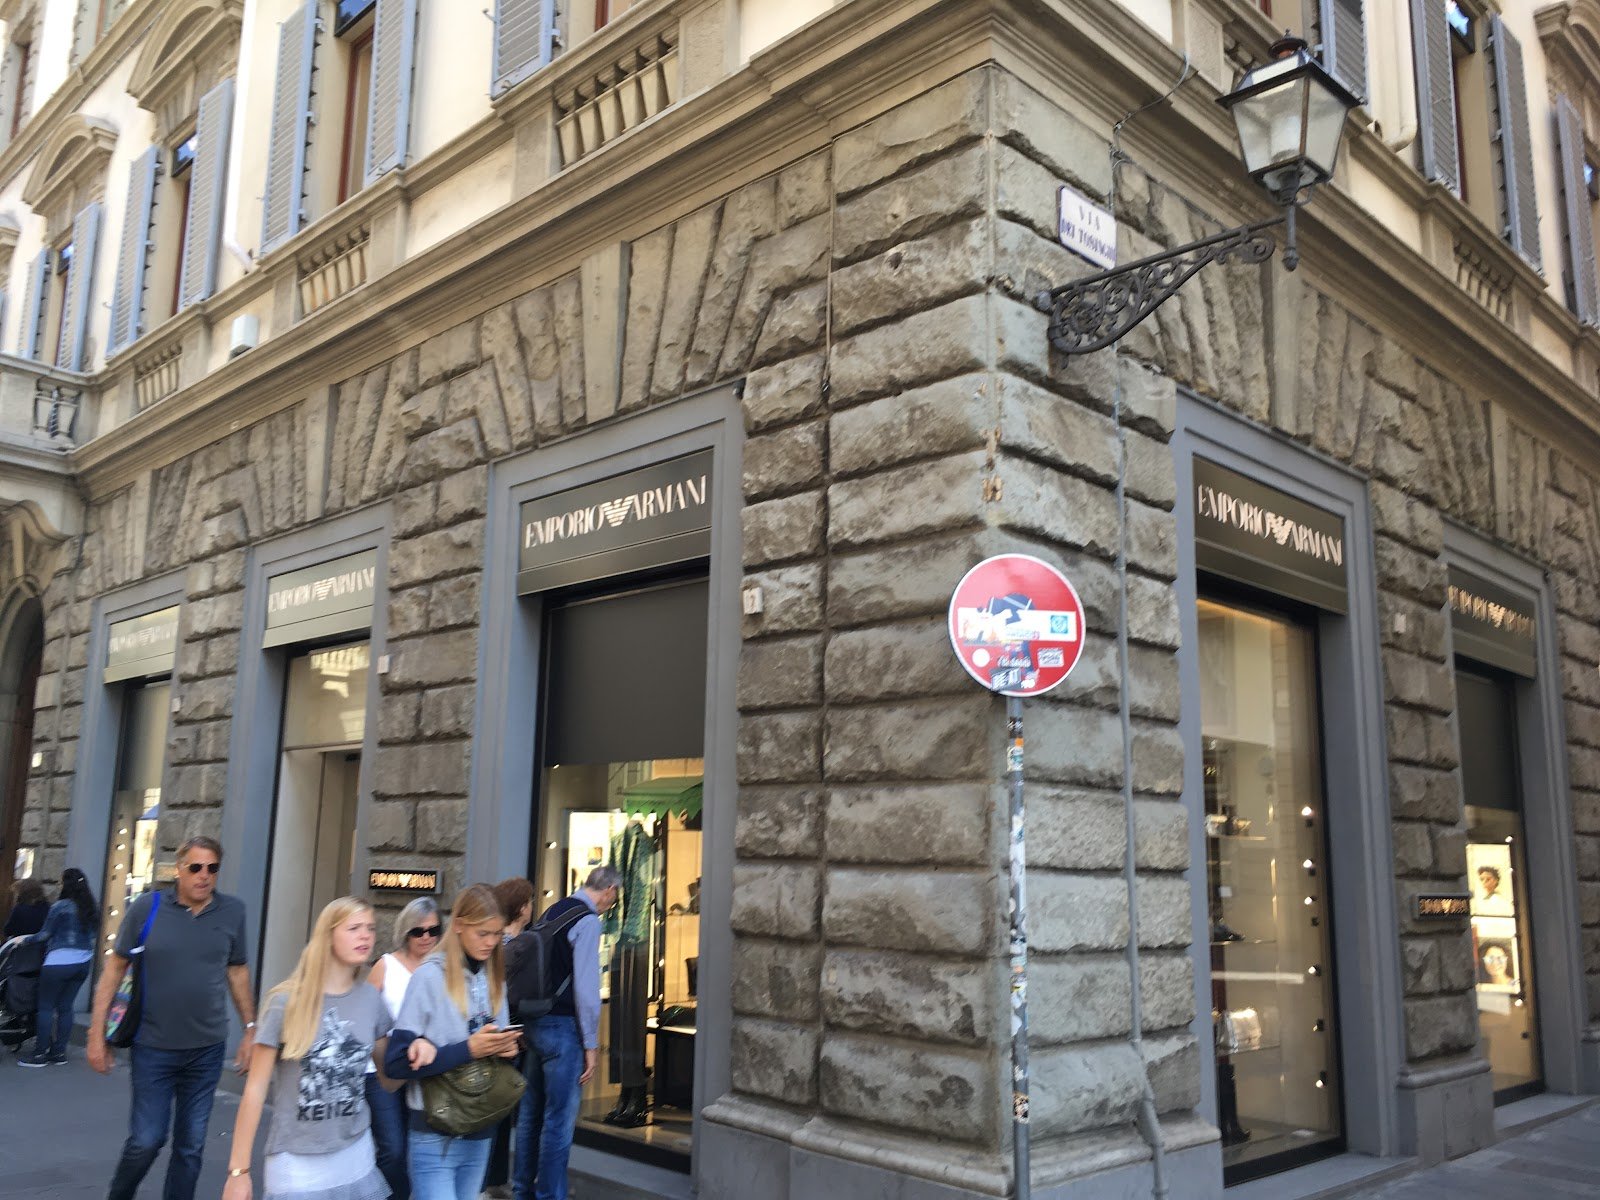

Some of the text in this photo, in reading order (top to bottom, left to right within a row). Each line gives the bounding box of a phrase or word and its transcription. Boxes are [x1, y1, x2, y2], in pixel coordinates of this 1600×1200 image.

[525, 474, 707, 549] EMPORIO ARMANI
[1197, 484, 1343, 567] EMPORIO ARMANI
